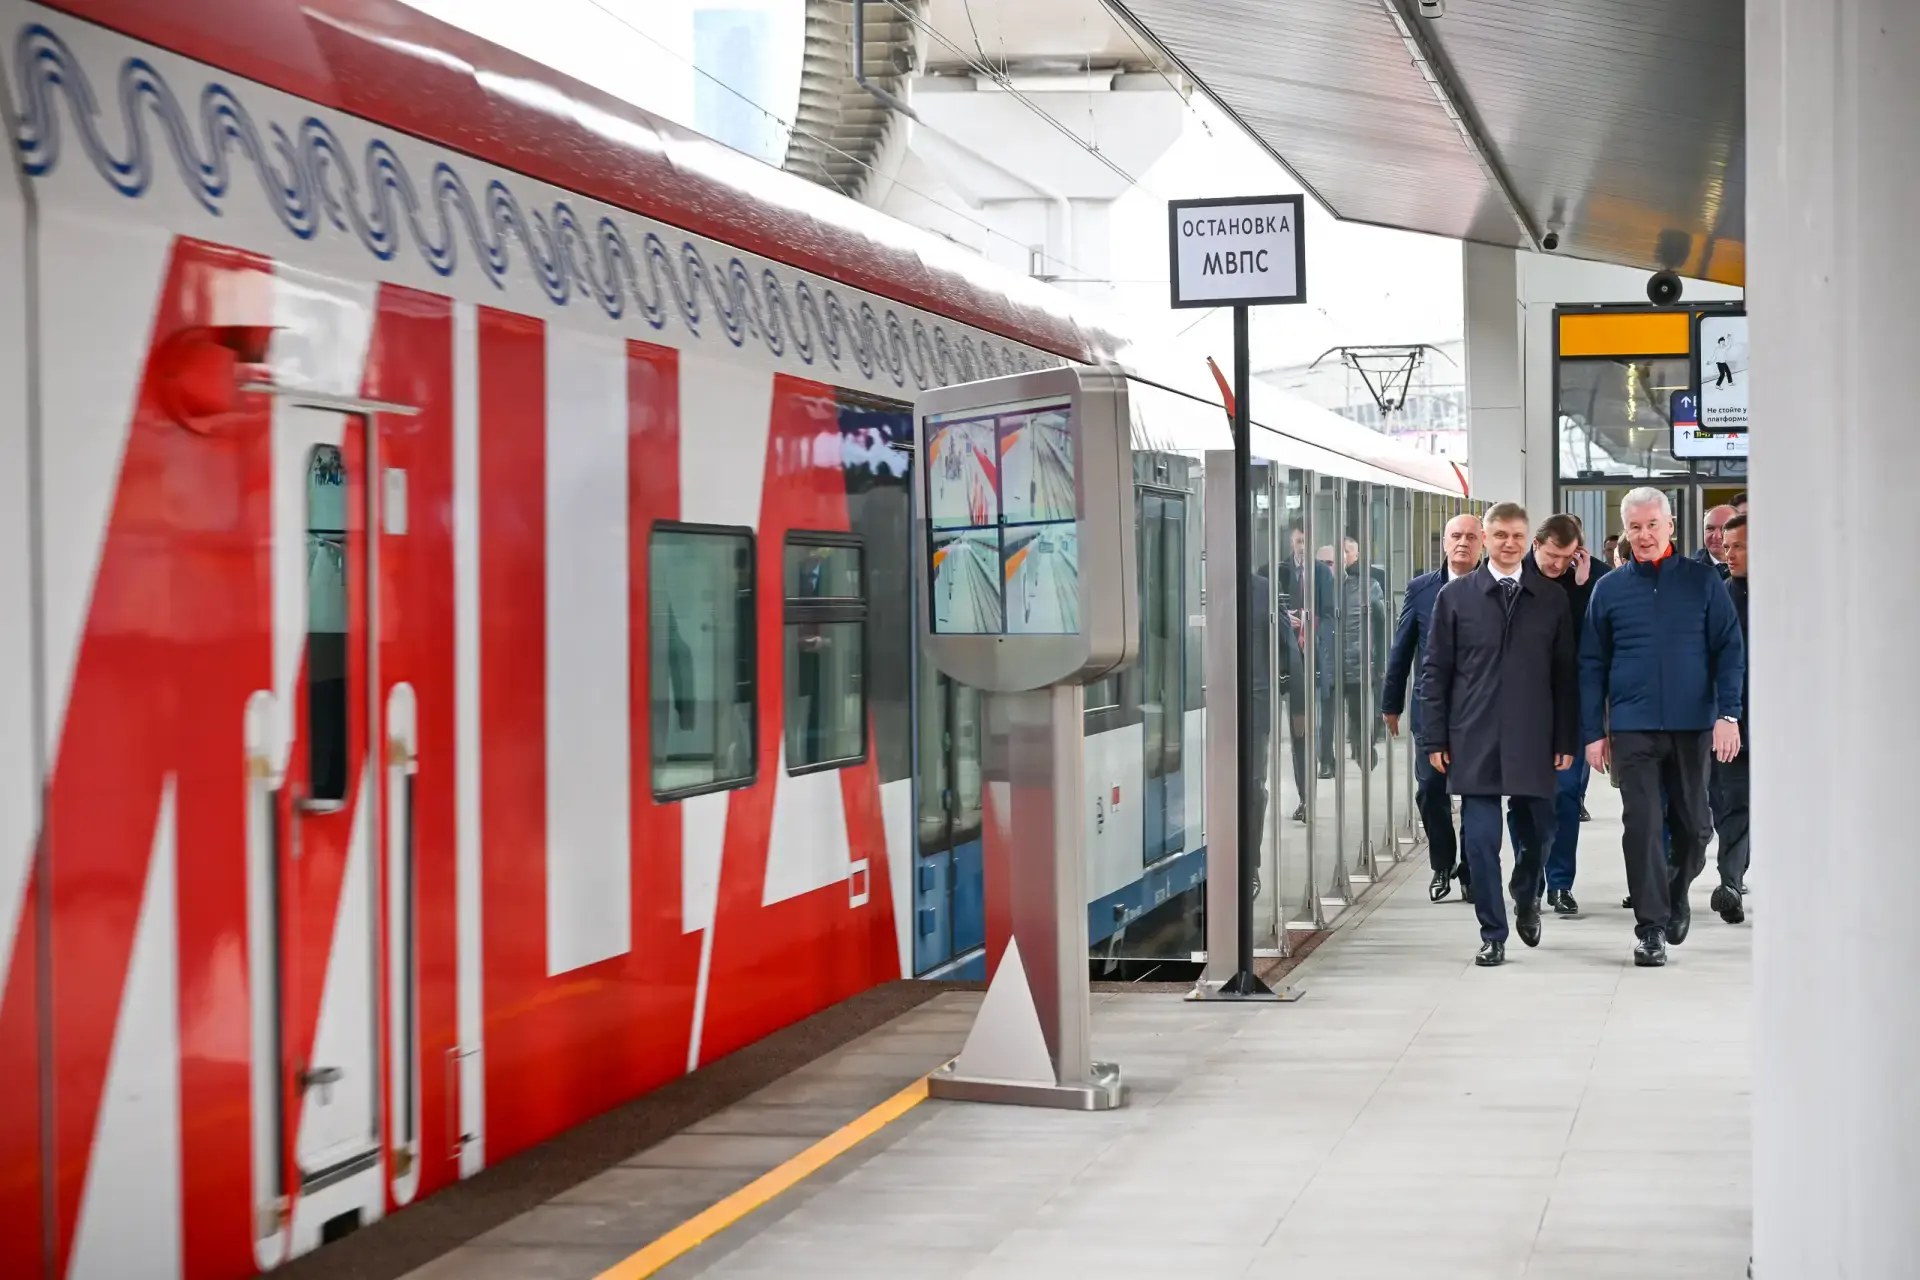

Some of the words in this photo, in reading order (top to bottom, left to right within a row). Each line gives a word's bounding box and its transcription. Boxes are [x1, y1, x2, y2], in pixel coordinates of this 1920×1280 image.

[1182, 215, 1290, 237] ОСТАНОВКА
[1202, 249, 1269, 275] МВПС
[1718, 406, 1742, 414] стойте
